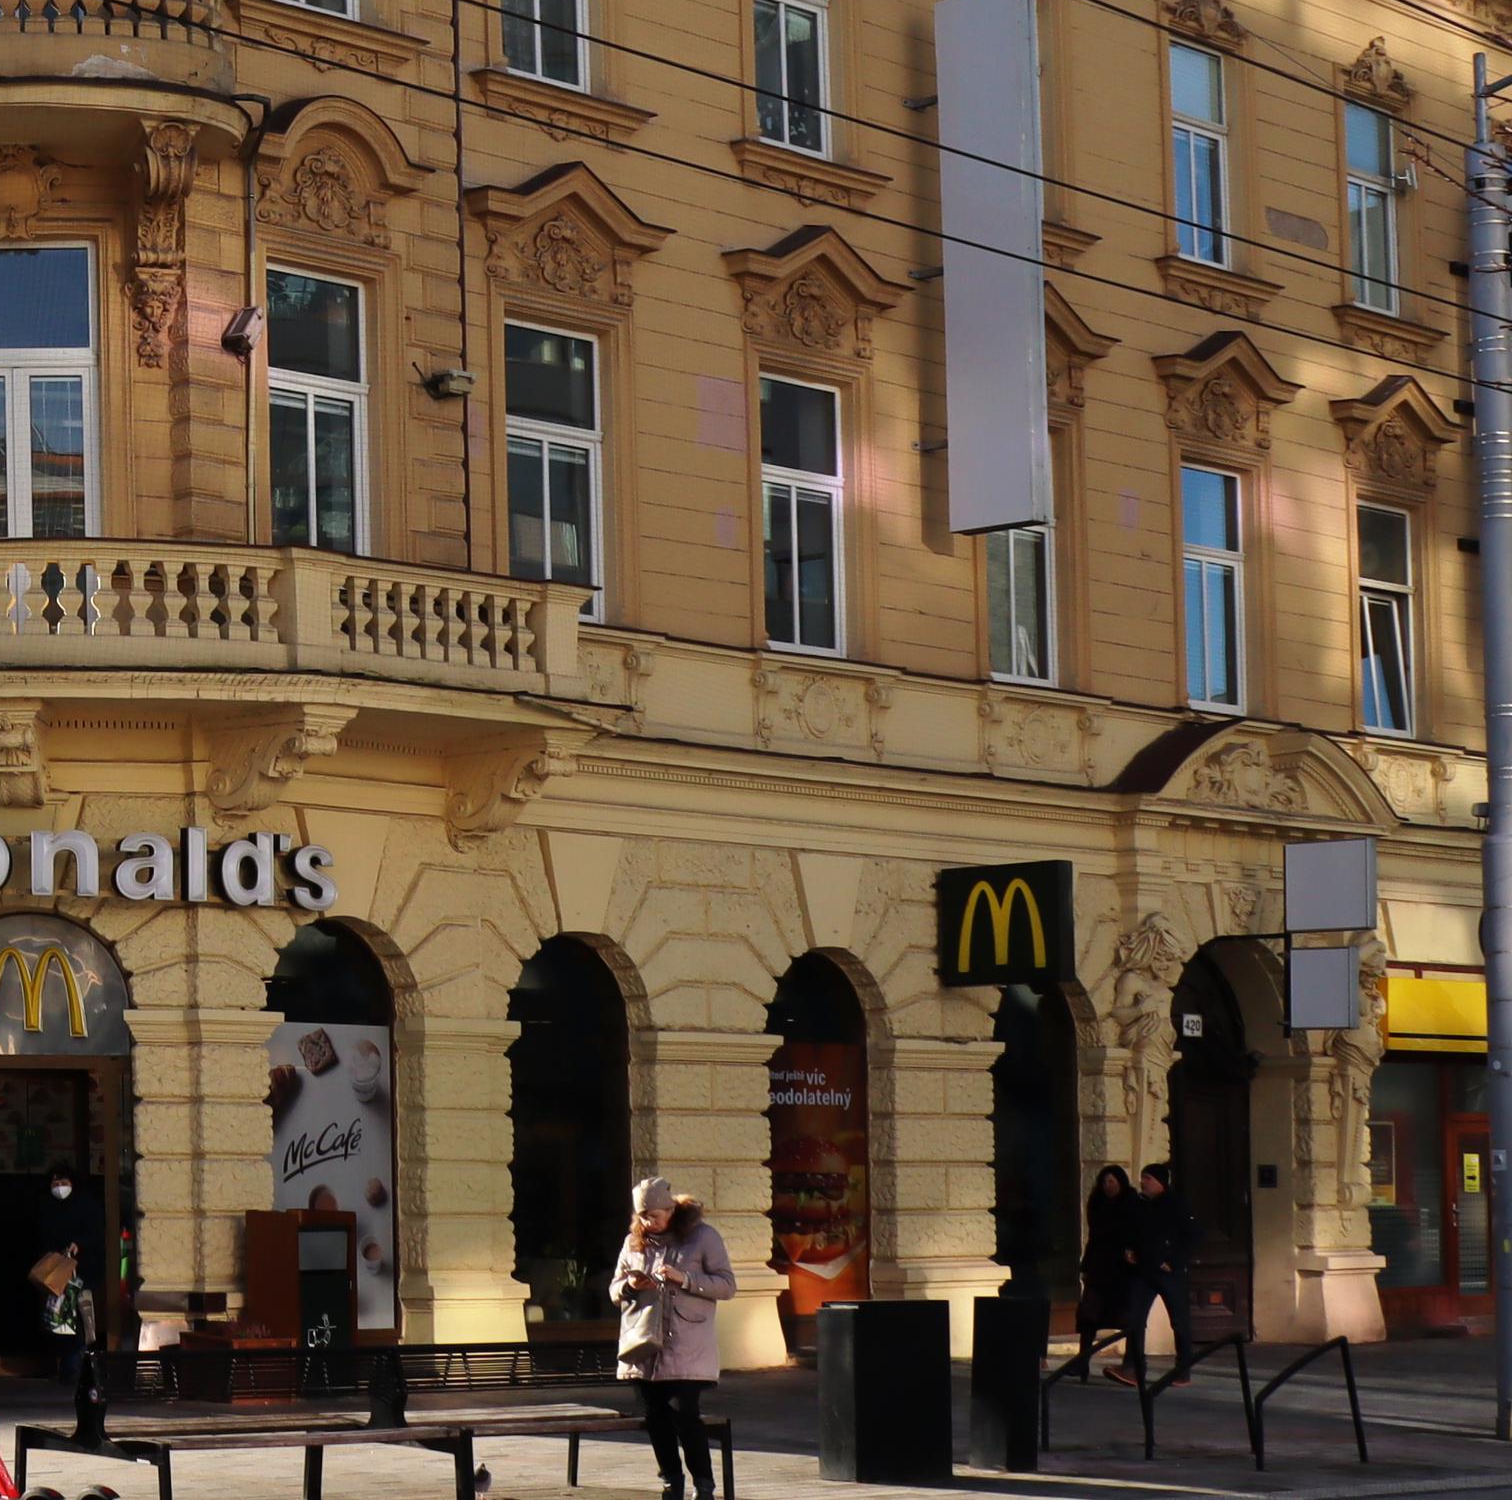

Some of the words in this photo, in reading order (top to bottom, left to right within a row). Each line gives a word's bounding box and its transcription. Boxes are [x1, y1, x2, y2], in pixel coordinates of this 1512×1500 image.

[806, 1068, 826, 1085] víc
[769, 1088, 851, 1110] eodolatelný
[283, 1117, 362, 1176] McCafé
